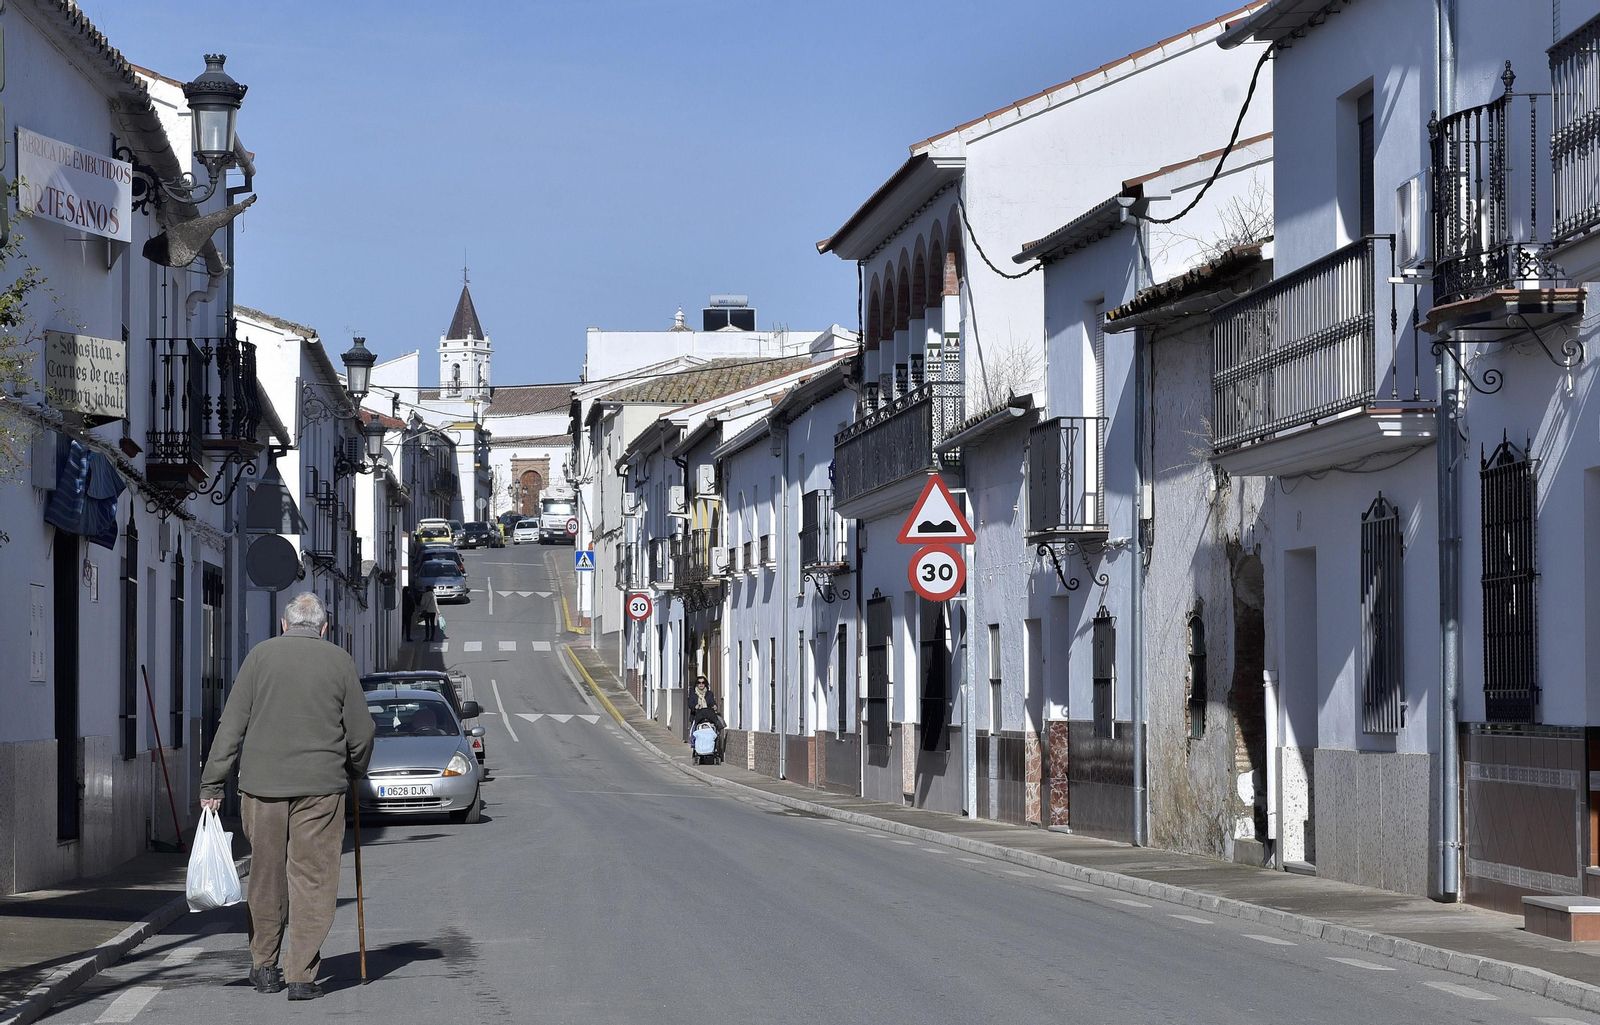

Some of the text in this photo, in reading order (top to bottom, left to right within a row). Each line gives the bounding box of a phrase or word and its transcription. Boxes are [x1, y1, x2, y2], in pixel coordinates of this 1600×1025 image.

[58, 145, 71, 167] DE
[73, 150, 131, 185] EMBUTIDOS
[24, 182, 120, 235] ARTESANOS
[60, 335, 112, 361] Sebastián
[47, 358, 125, 385] Carnes de caza
[921, 563, 953, 582] 30
[632, 602, 647, 612] 30
[387, 786, 427, 796] 0628 DJK
